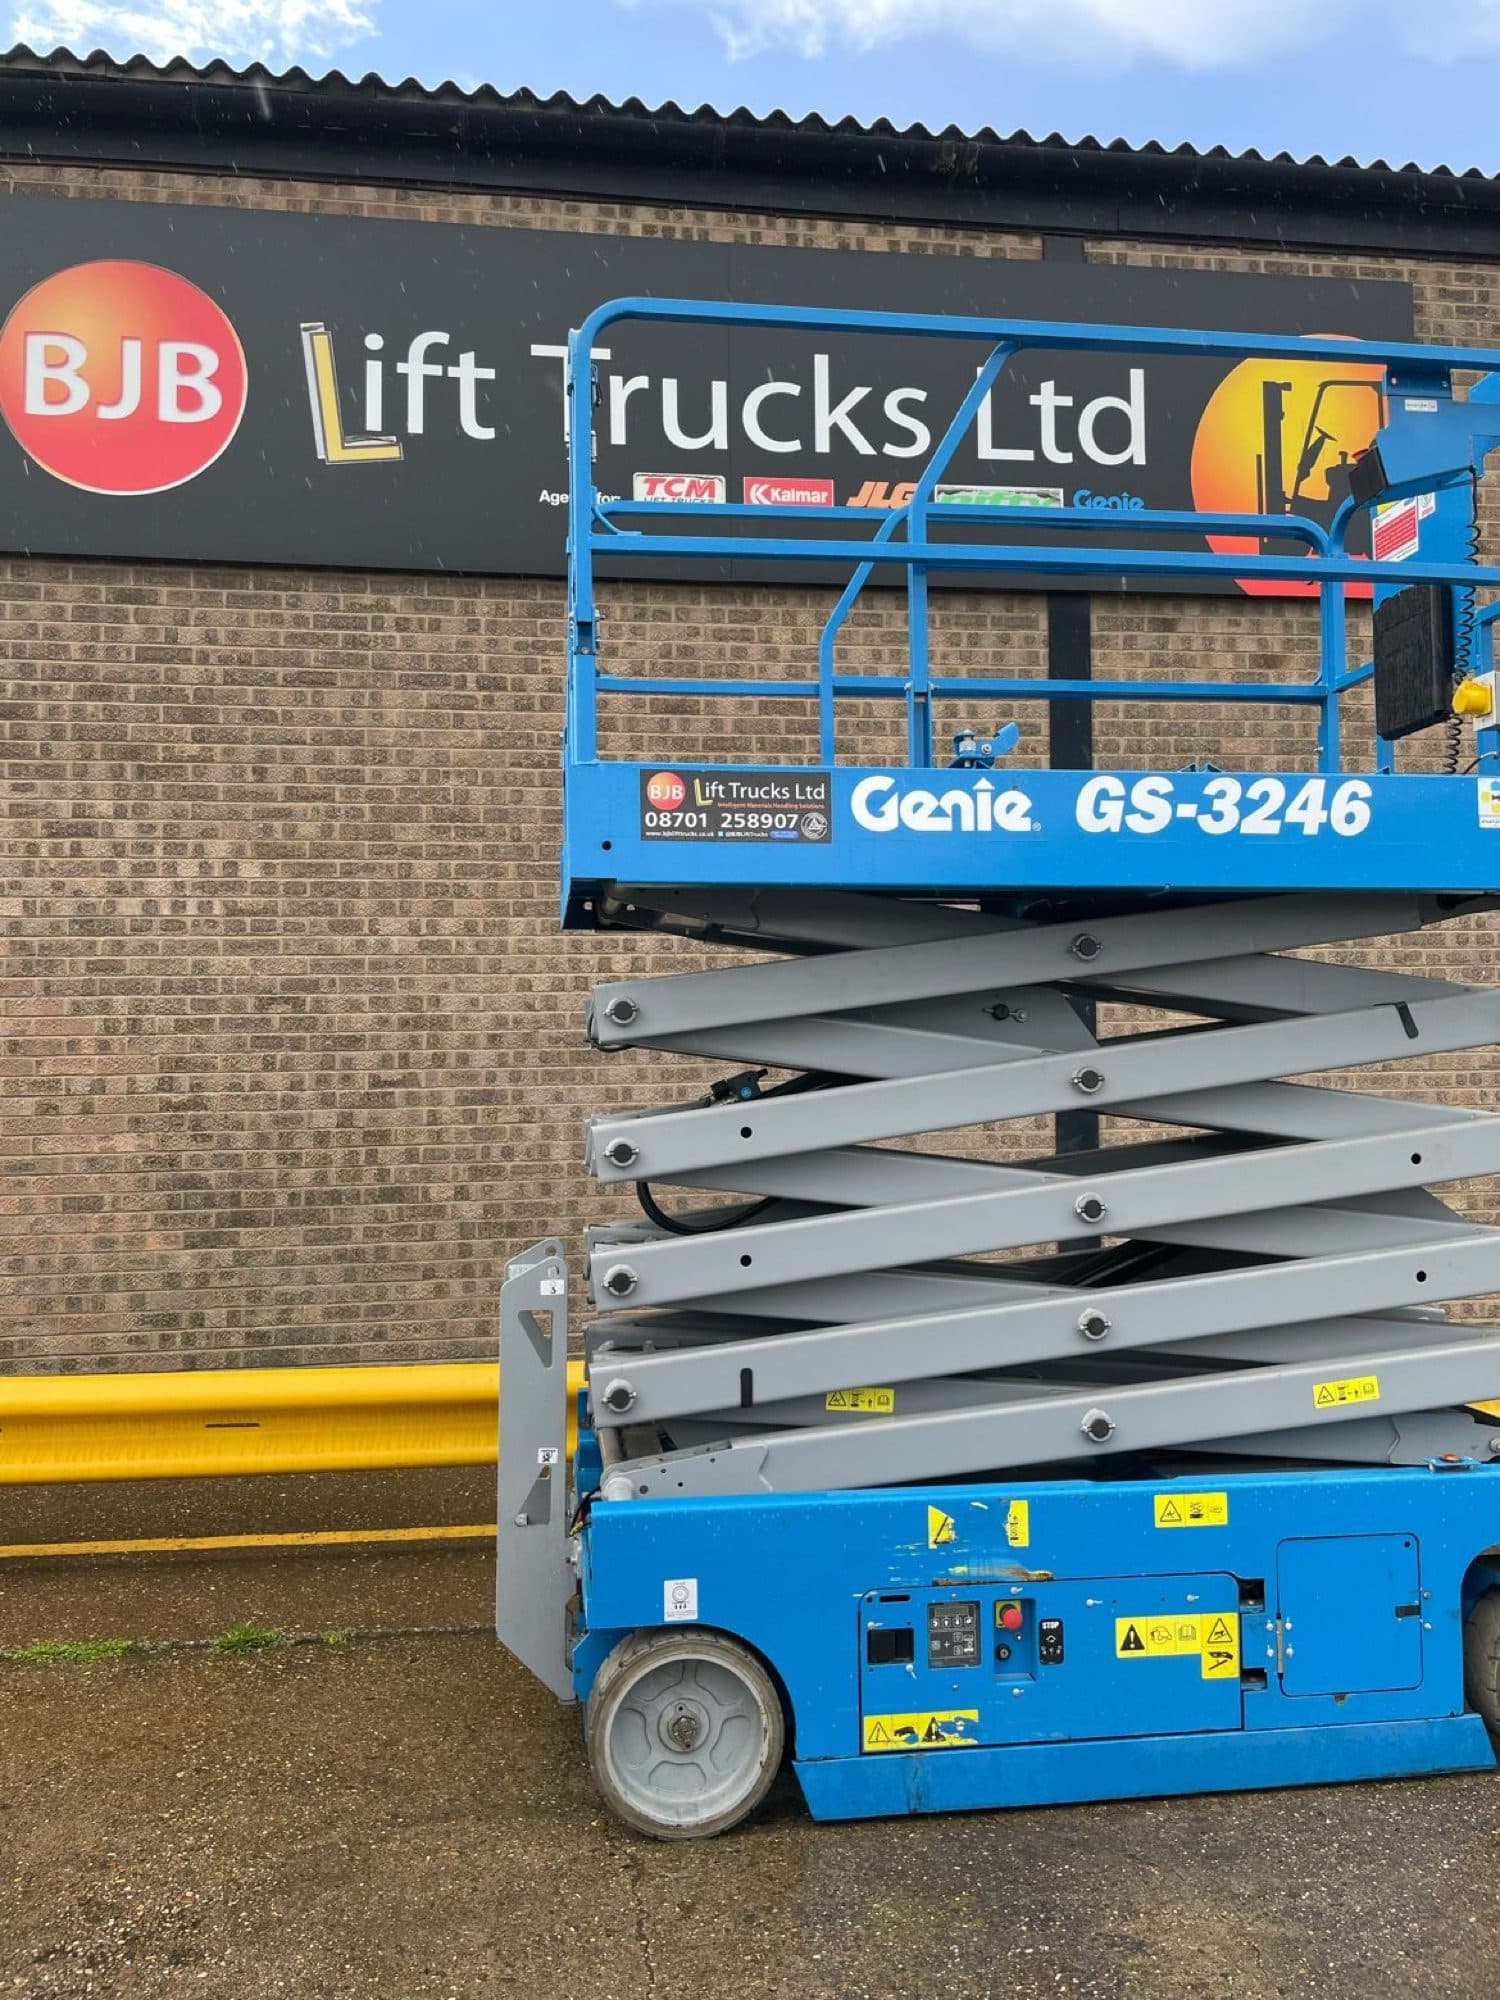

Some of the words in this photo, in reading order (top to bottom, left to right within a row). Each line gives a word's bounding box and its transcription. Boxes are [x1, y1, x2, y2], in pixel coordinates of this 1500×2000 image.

[23, 332, 223, 423] BJB
[300, 322, 496, 463] Lift
[977, 366, 1147, 465] Ltd
[643, 477, 716, 498] TCM
[770, 487, 829, 504] Kalmar
[846, 481, 919, 508] JLG
[1073, 488, 1145, 510] Genie
[650, 784, 684, 800] BJB
[693, 777, 726, 807] Lift
[728, 782, 790, 799] Trucks
[795, 782, 825, 800] Ltd
[850, 775, 1033, 832] Genie
[1075, 775, 1373, 836] GS-3246
[645, 812, 708, 828] 08701
[720, 812, 799, 829] 258907
